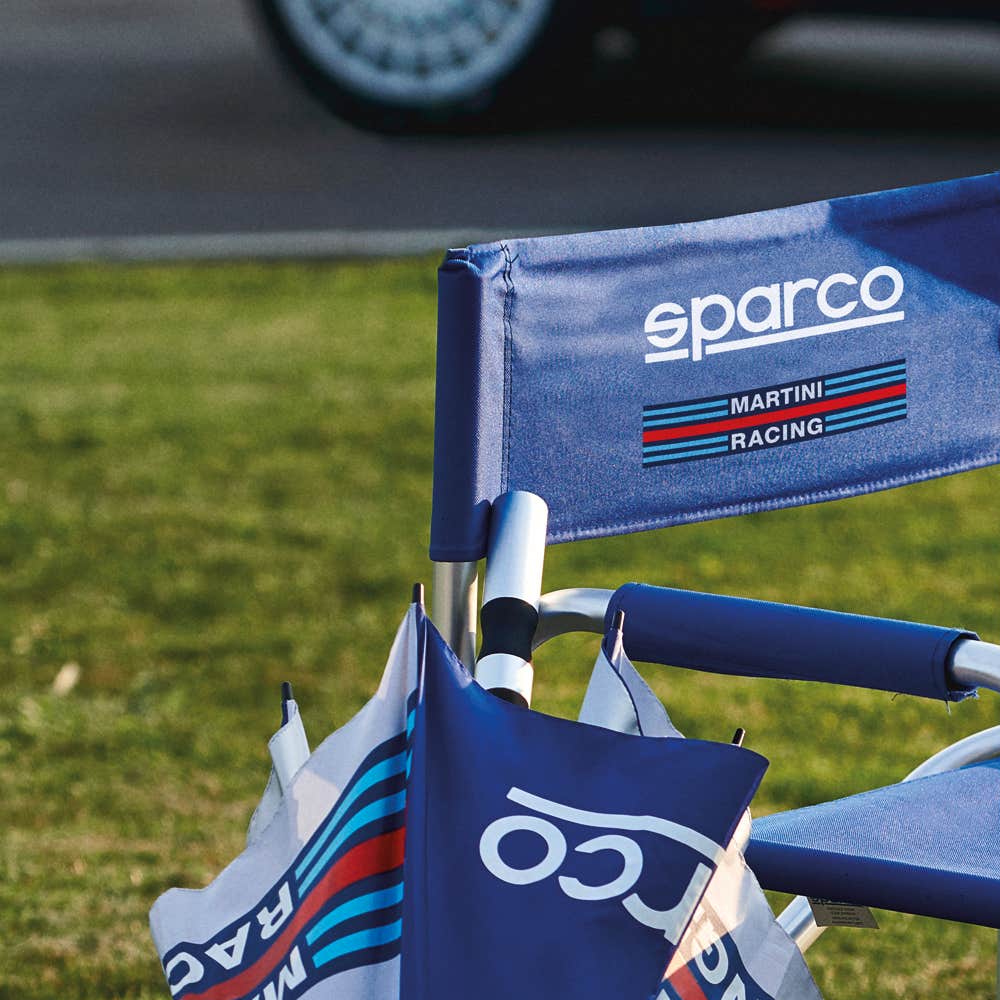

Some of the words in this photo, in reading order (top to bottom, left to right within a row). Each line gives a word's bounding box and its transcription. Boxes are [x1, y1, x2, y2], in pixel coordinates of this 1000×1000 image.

[644, 265, 905, 363] sparco
[730, 380, 823, 415] MARTINI
[730, 417, 823, 451] RACING
